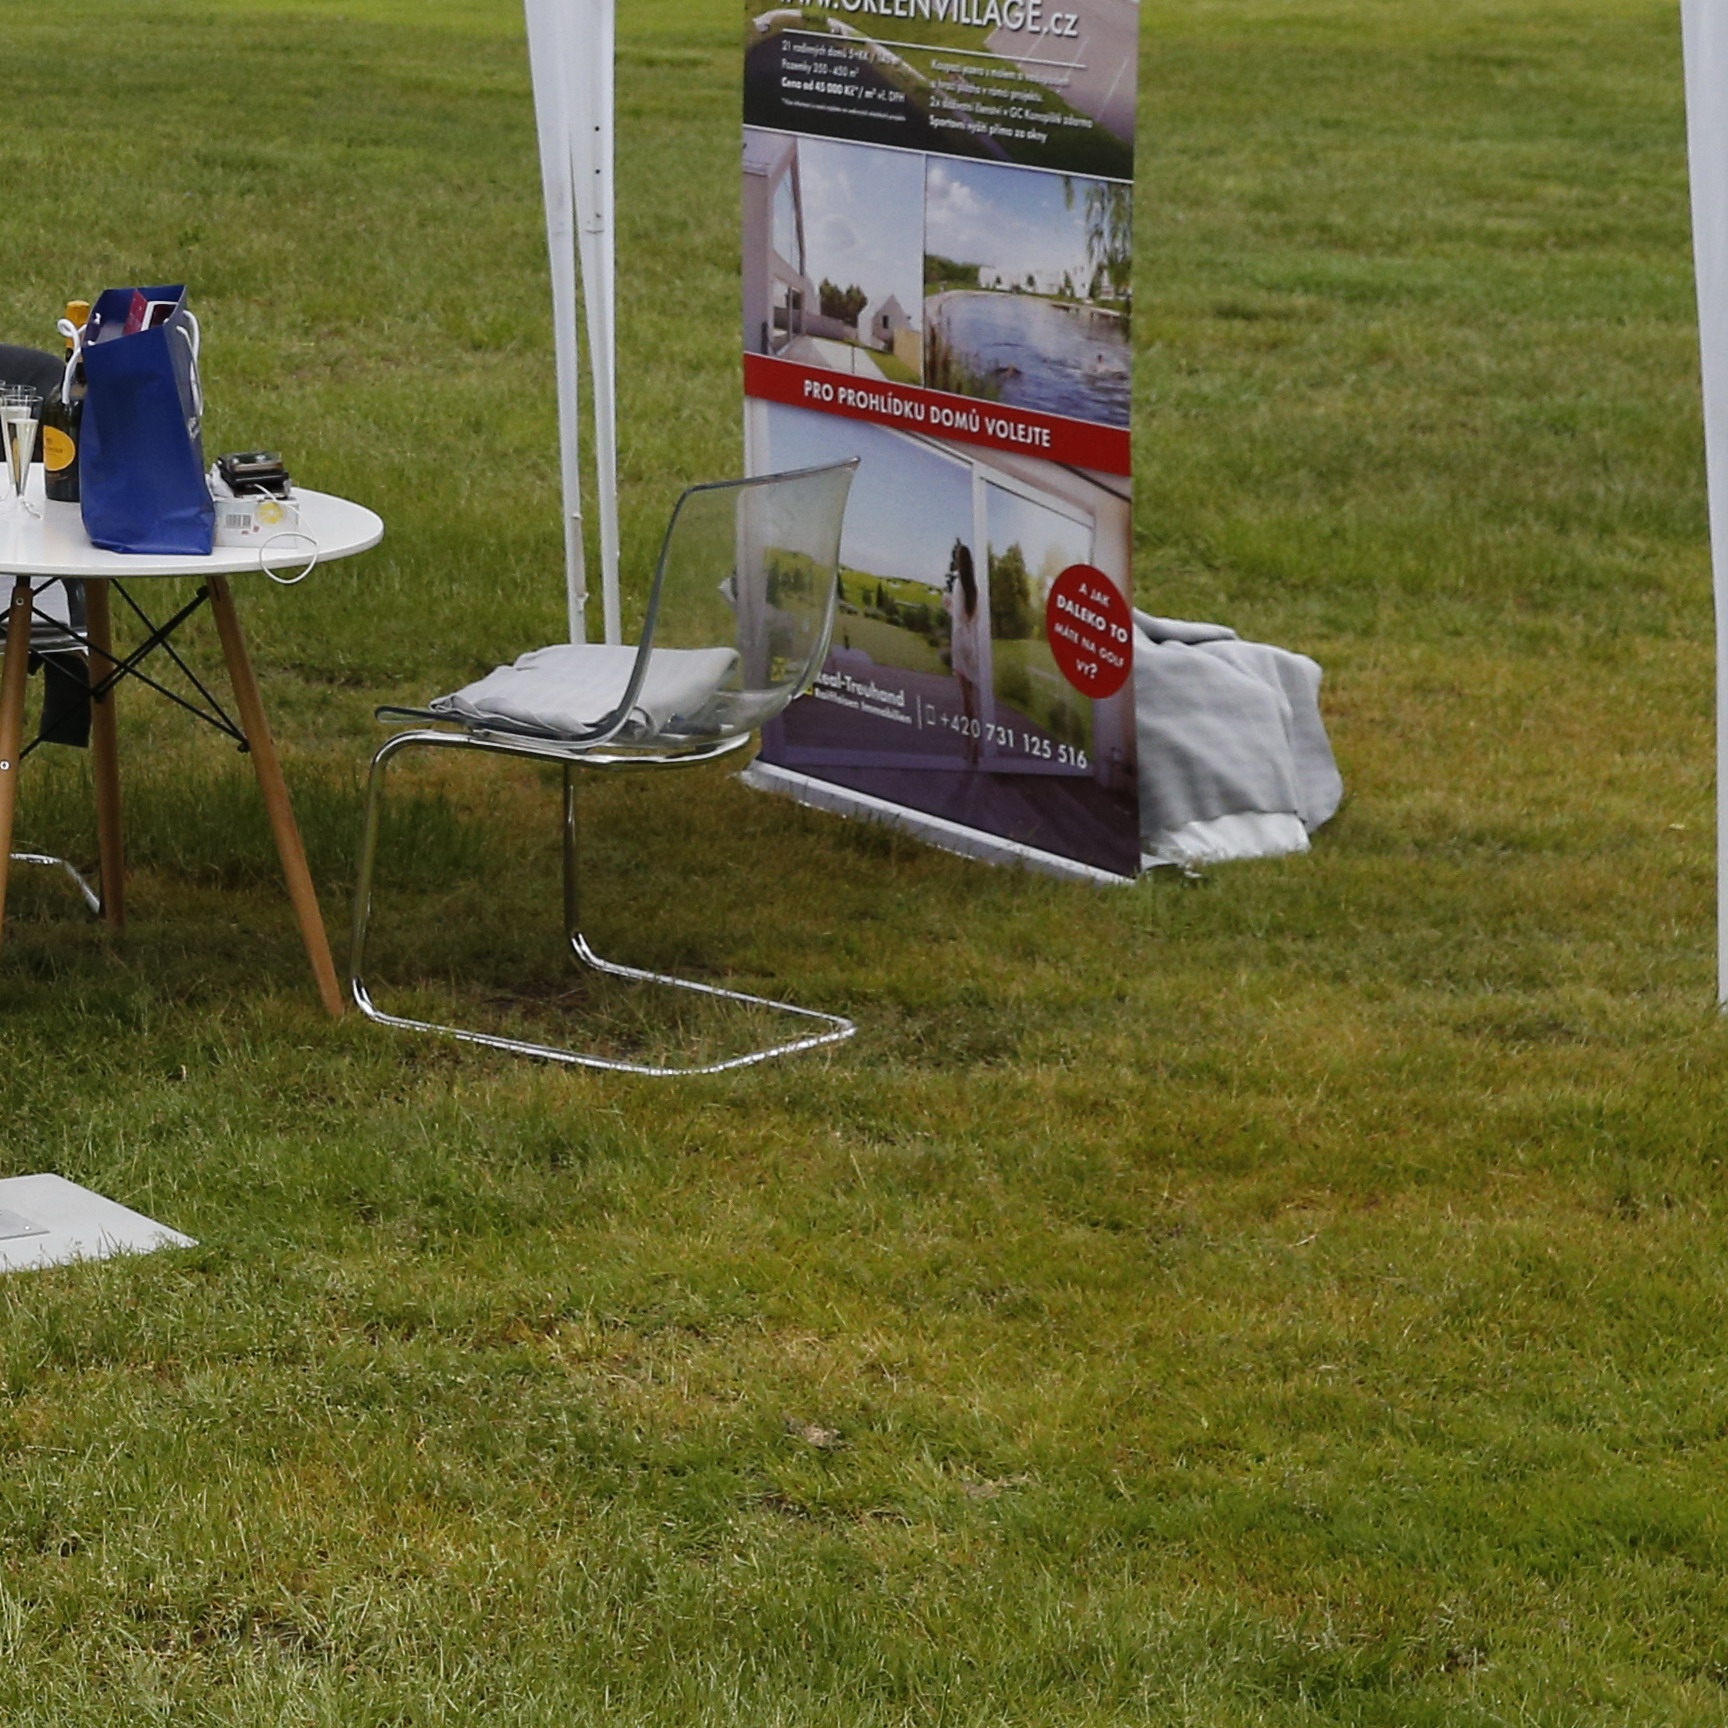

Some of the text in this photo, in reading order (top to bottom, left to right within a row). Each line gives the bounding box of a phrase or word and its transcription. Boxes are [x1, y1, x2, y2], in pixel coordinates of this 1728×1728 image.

[803, 379, 1051, 447] PRO PROHLÍDKU DOMŮ VOLEJTE
[1078, 583, 1088, 595] A
[1056, 594, 1128, 643] DALEKO TO
[1098, 647, 1125, 668] GOLF
[940, 715, 1088, 769] +420 731 125 516
